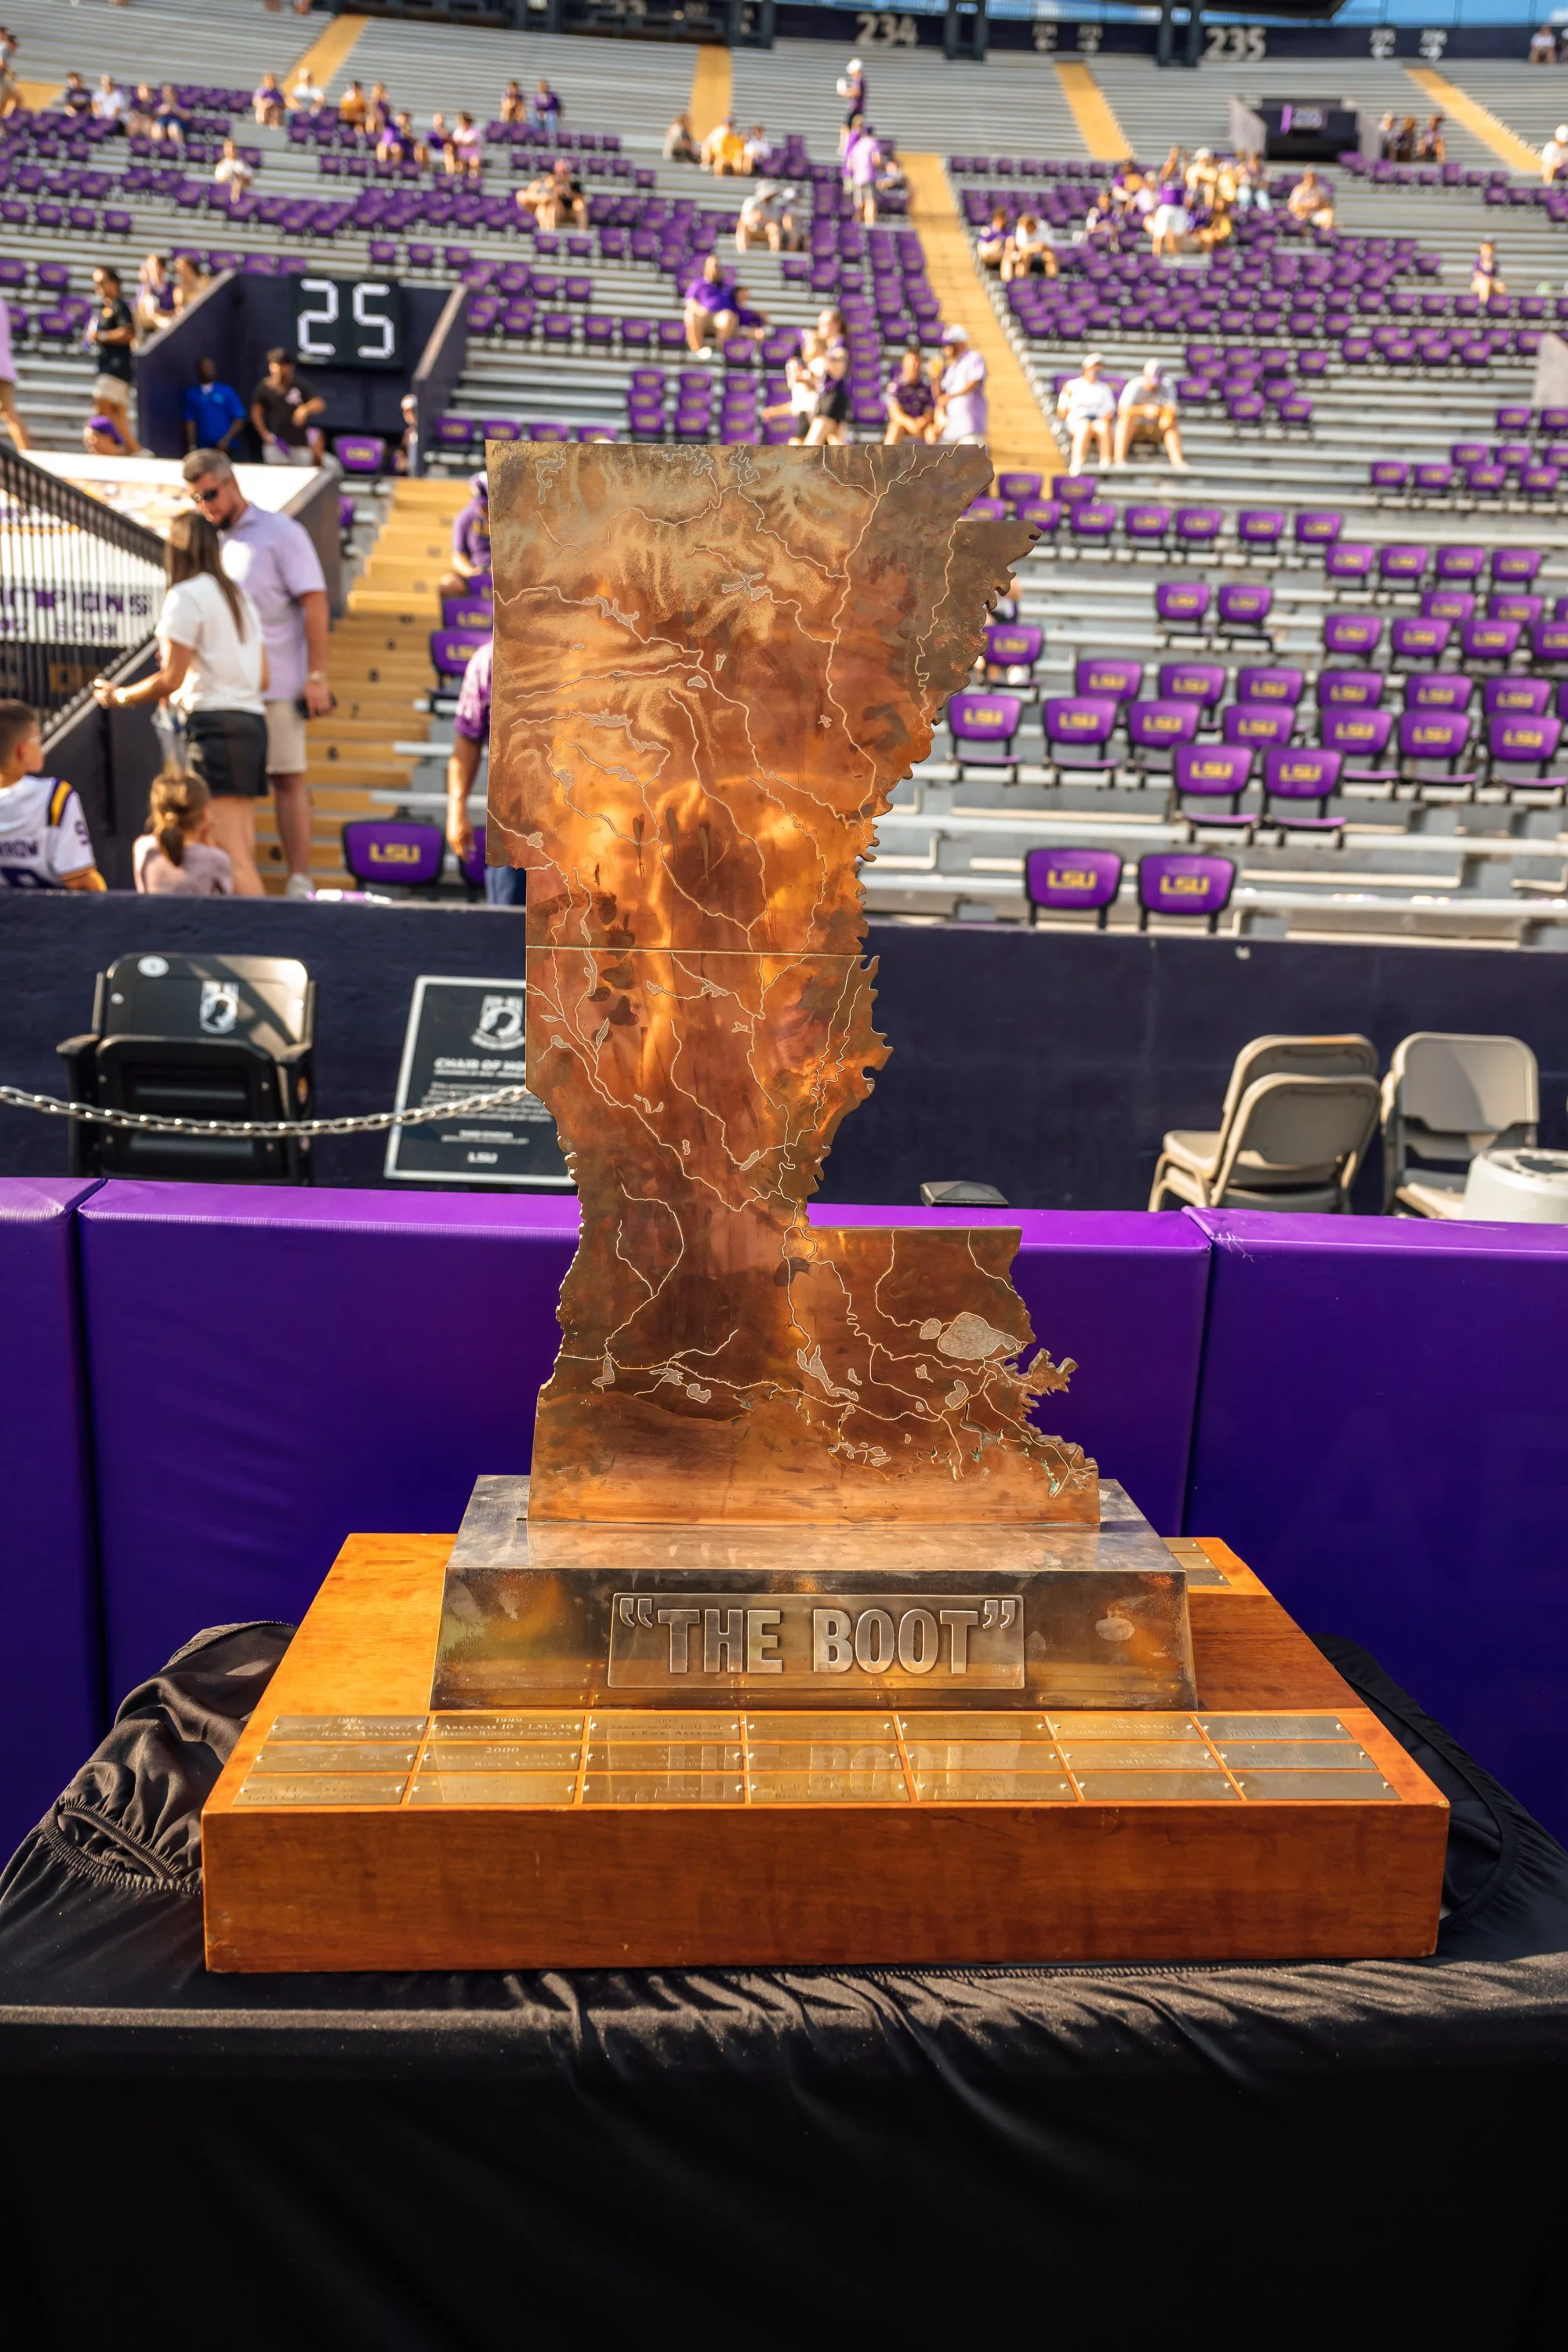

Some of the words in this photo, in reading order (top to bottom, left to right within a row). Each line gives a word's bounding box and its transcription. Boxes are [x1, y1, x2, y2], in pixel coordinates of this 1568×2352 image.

[855, 13, 919, 48] 234
[1203, 26, 1266, 62] 235
[297, 278, 395, 360] 25
[1191, 762, 1233, 779] LSU
[1279, 764, 1322, 782] LSU
[369, 843, 420, 864] LSU
[1047, 870, 1097, 890] LSU
[1160, 876, 1210, 895] LSU
